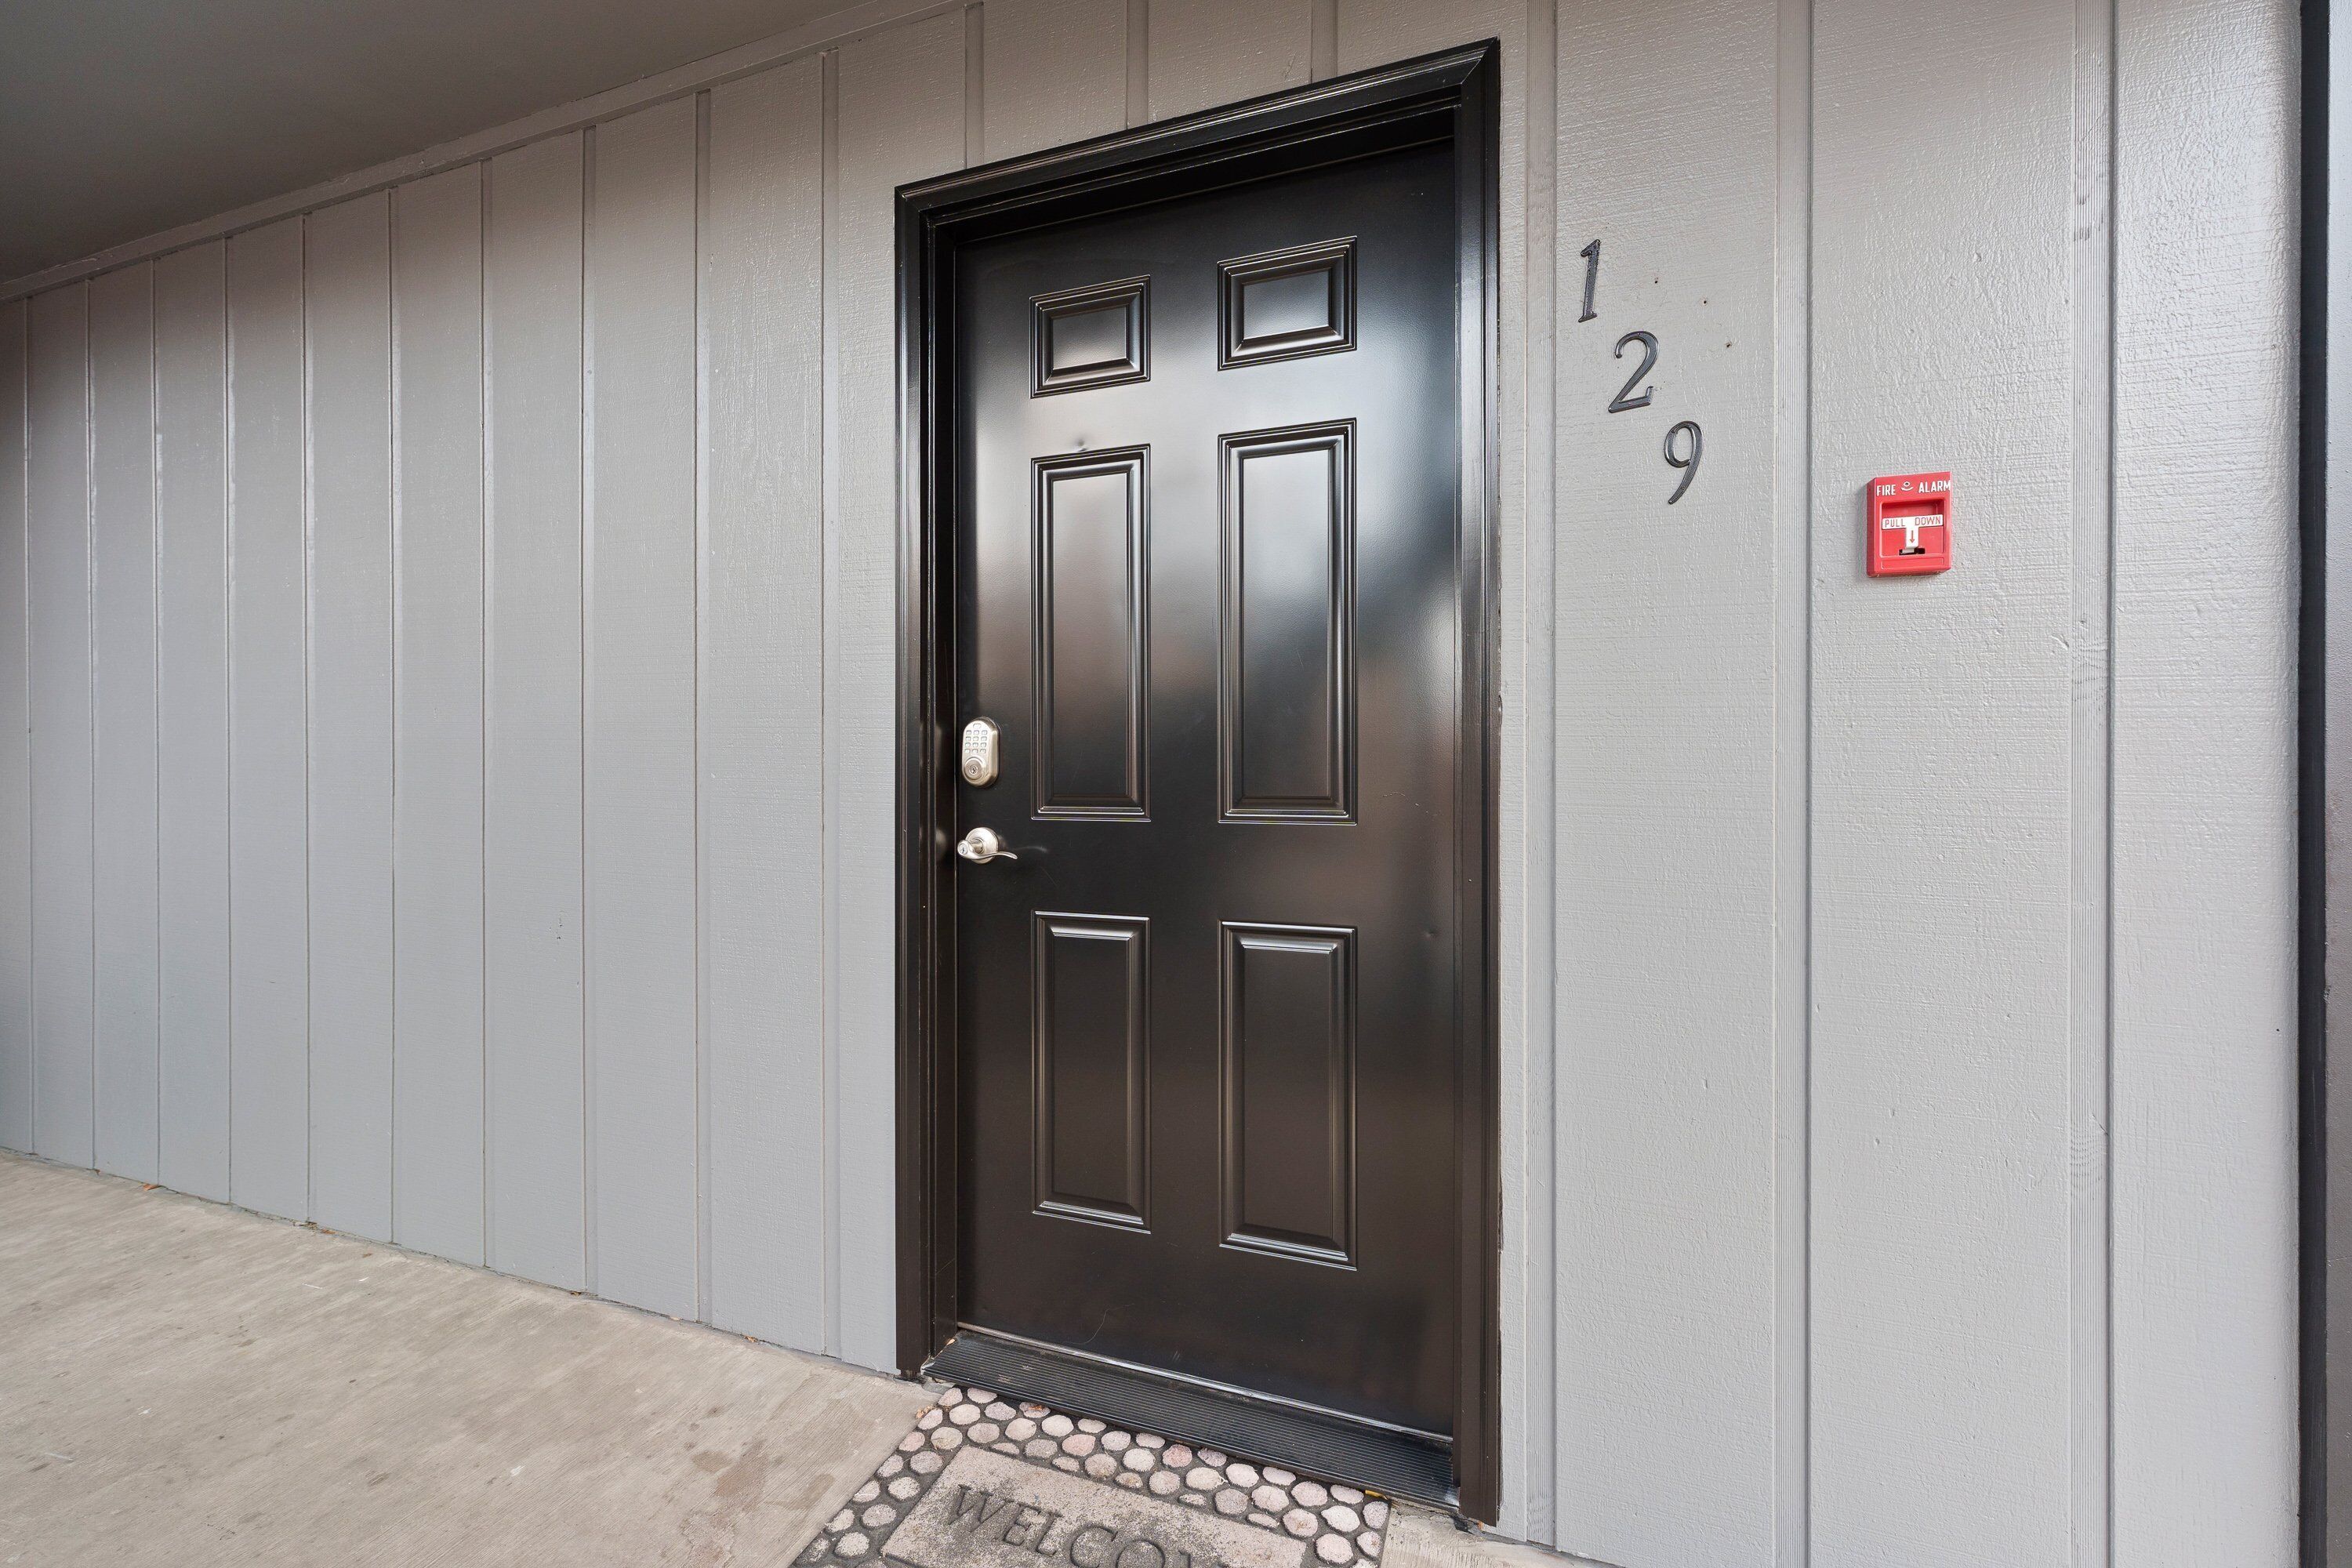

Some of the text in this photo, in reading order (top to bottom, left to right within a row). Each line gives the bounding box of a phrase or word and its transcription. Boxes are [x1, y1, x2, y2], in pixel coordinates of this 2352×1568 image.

[1577, 238, 1704, 505] 129
[1876, 479, 1951, 496] FIRE ALARM
[1915, 517, 1941, 526] DOWN
